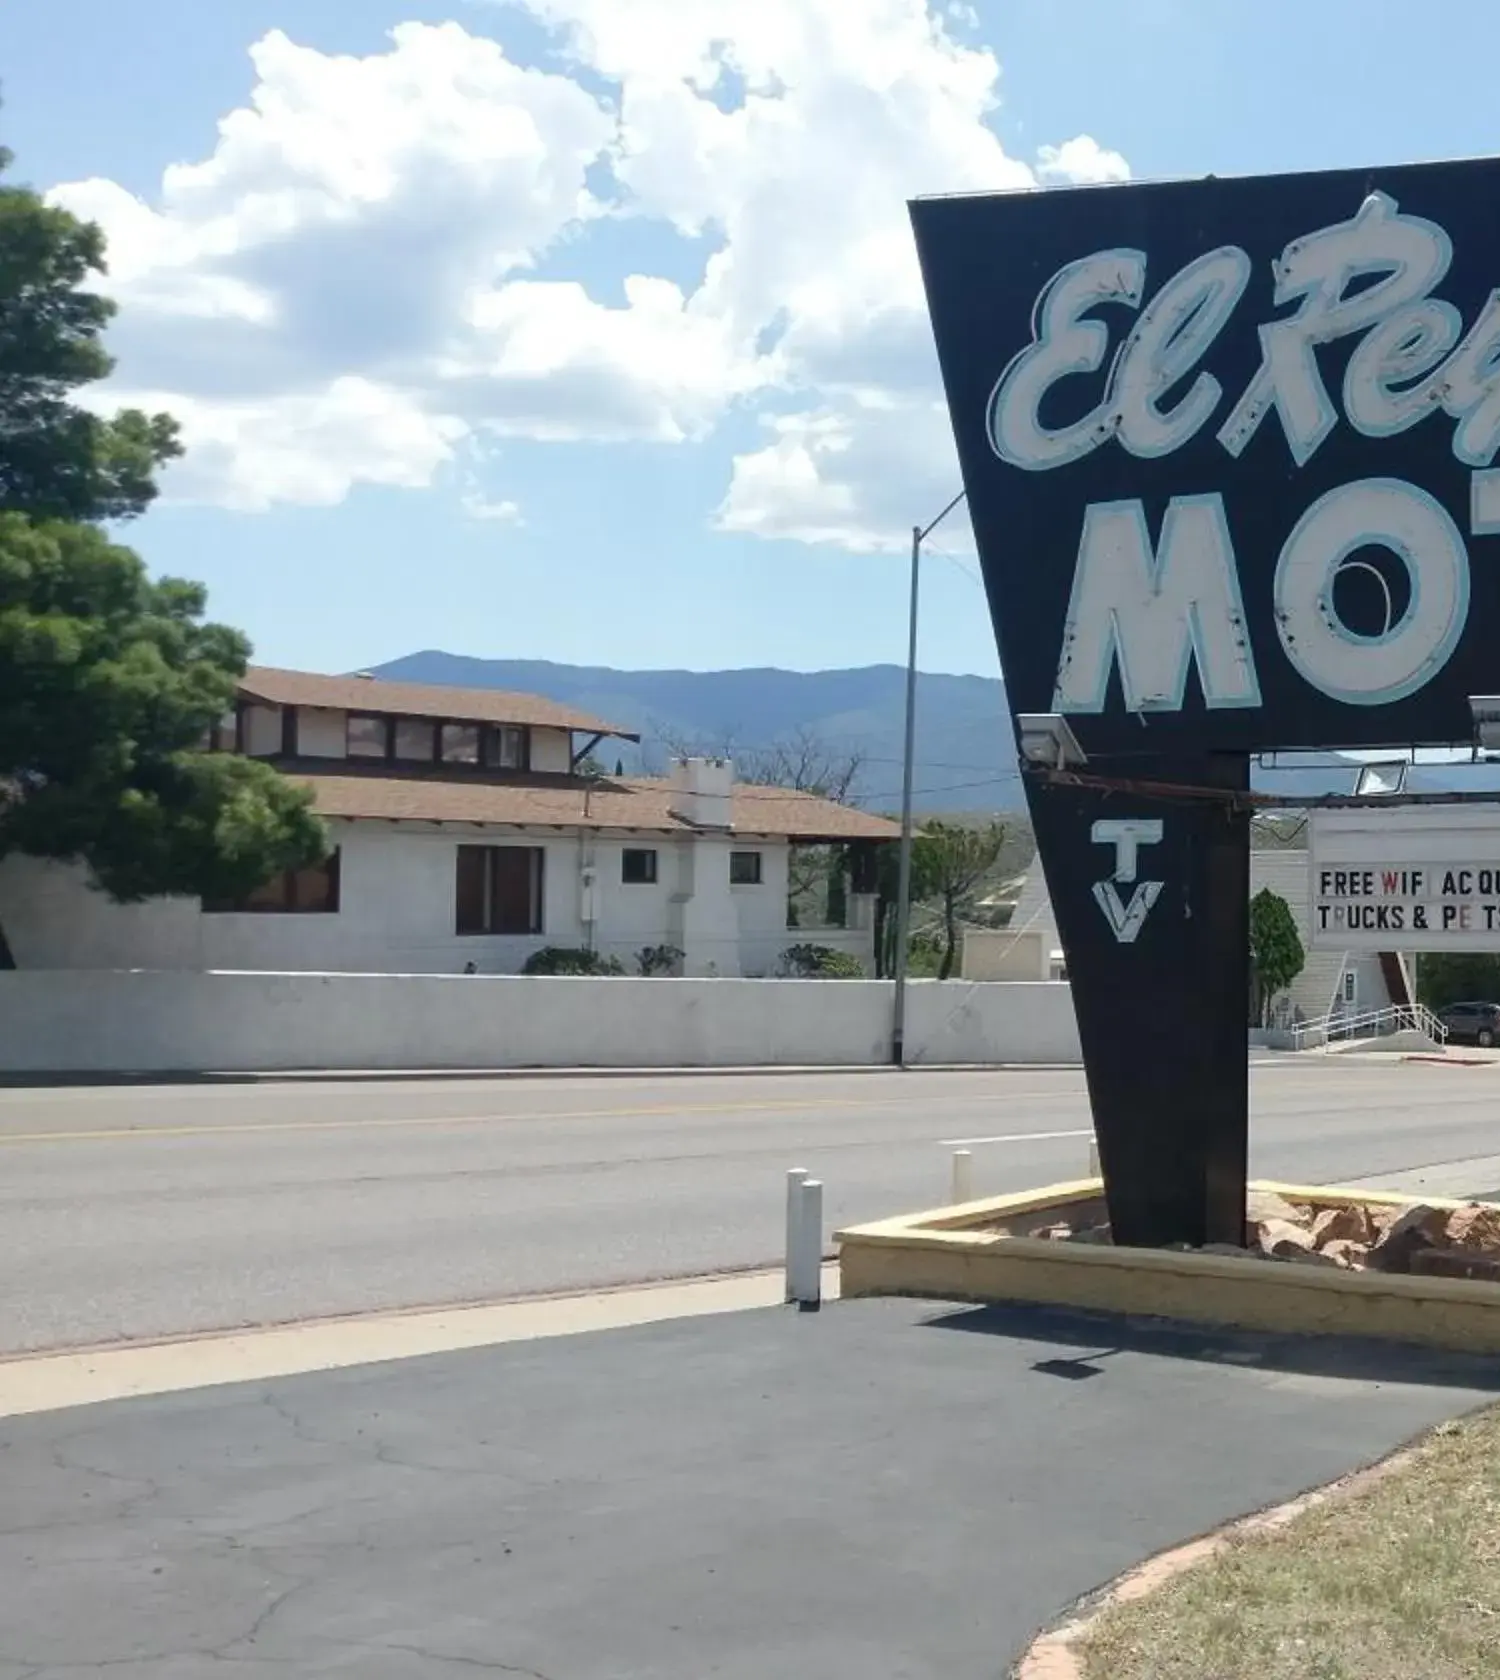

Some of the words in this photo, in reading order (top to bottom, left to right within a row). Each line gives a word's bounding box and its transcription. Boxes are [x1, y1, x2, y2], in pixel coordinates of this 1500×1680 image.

[986, 246, 1252, 471] El
[1091, 819, 1164, 942] TV
[1318, 905, 1405, 929] TRUCKS
[1413, 905, 1429, 929] &
[1320, 871, 1374, 896] FREE
[1442, 870, 1473, 896] AC
